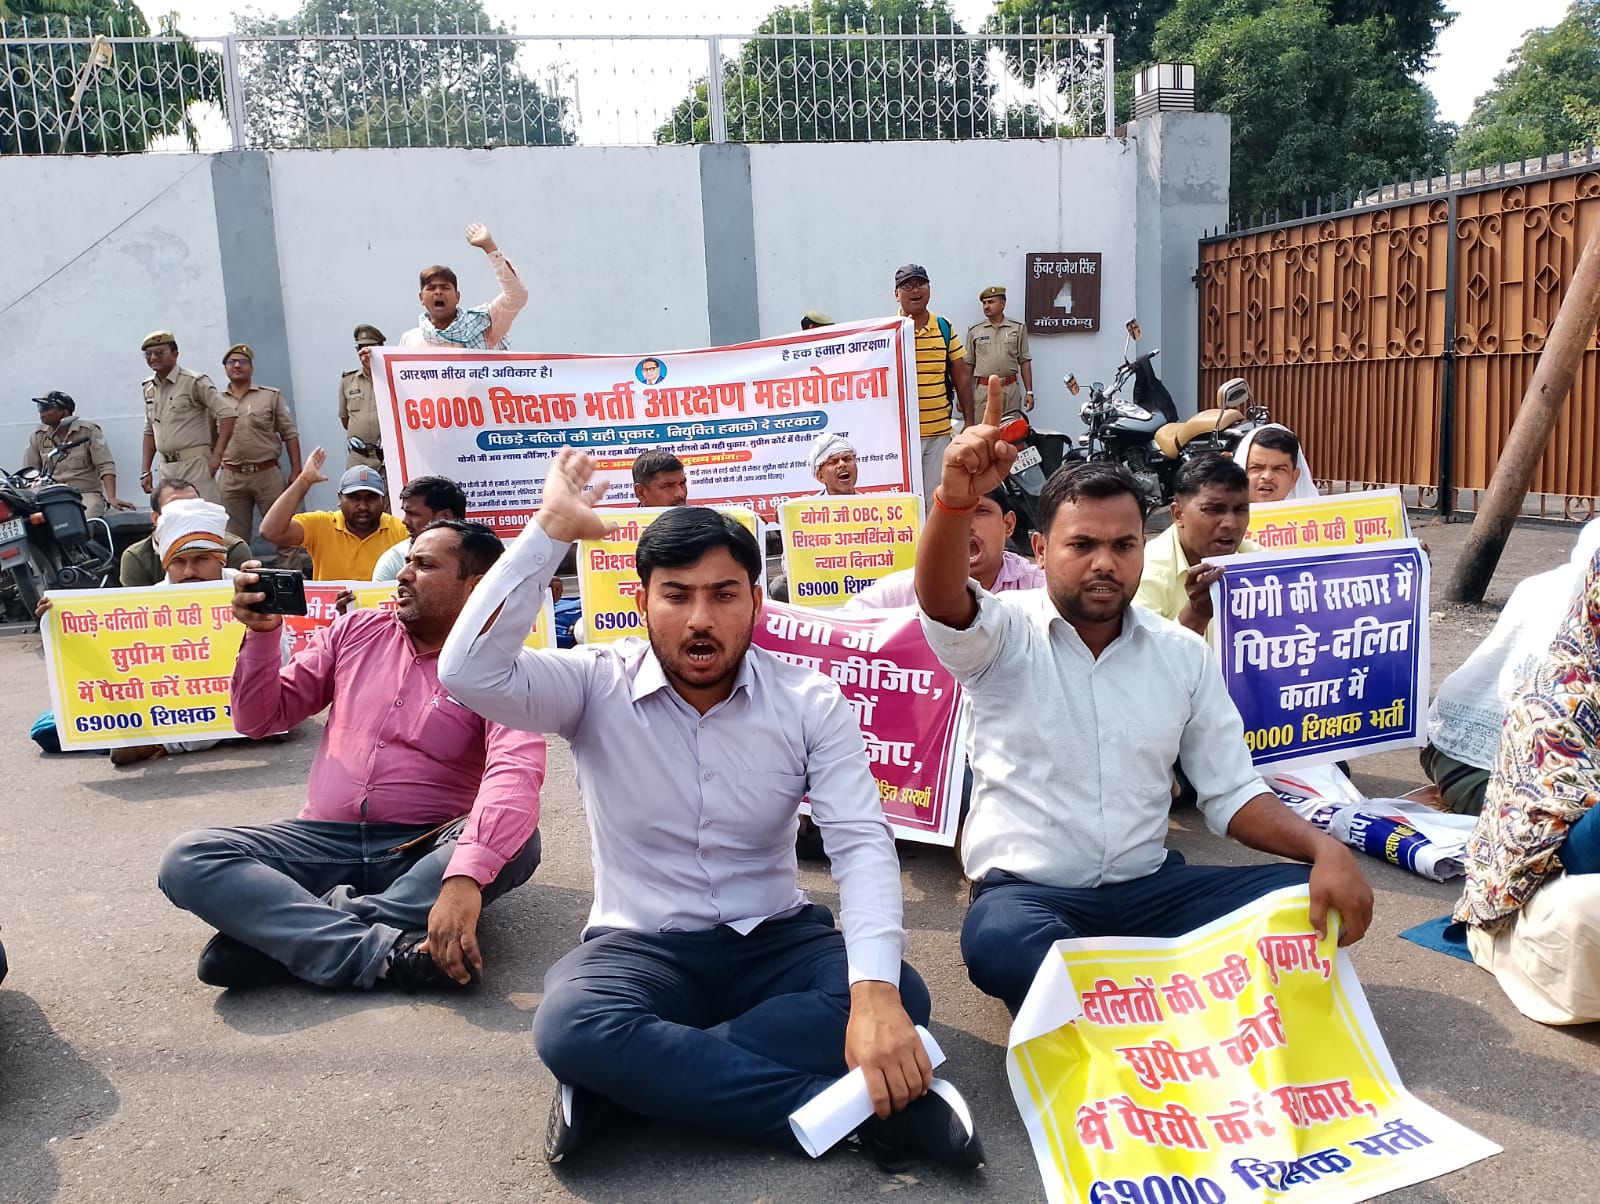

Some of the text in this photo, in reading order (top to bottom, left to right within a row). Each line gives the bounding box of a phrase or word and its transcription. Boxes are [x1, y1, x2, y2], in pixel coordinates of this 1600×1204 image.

[1079, 257, 1096, 275] सिंह
[1053, 281, 1072, 314] 4
[1034, 316, 1060, 327] मॉल
[782, 349, 791, 361] है
[793, 347, 812, 360] हक
[815, 343, 846, 359] हमारा
[400, 367, 438, 381] आरक्षण
[440, 366, 466, 380] भीख
[492, 365, 537, 379] अधिकार
[404, 366, 890, 430] 69000 शिक्षक भर्ती आरक्षण महाघोटाला
[488, 430, 566, 446] पिछड़े-दलितों
[570, 430, 590, 443] की
[591, 429, 616, 441] यही
[619, 428, 660, 445] पुकार,
[718, 418, 760, 434] हमको
[773, 414, 822, 429] सरकार
[458, 452, 476, 463] योगी
[700, 441, 710, 450] की
[801, 505, 903, 525] योगी जी OBC, SC
[792, 525, 914, 548] शिक्षक अभ्यर्थियों को
[1243, 515, 1392, 549] -दलितों की यही पुकार,
[815, 556, 847, 570] न्याय
[797, 580, 839, 597] 69000
[1230, 562, 1414, 620] योगी की सरकार में
[61, 602, 237, 638] पिछड़े-दलितों की यही पुक
[111, 637, 210, 673] सुप्रीम कोर्ट
[1233, 616, 1413, 677] पिछड़े-दलित
[78, 675, 231, 703] में पैरवी करें सरक
[829, 656, 944, 701] कीजिए,
[1279, 666, 1371, 712] कतार में
[75, 712, 143, 733] 69000
[149, 704, 217, 727] शिक्षक
[1244, 697, 1406, 751] 9000 शिक्षक भर्ती
[899, 784, 933, 809] अभ्यर्थी
[1080, 976, 1164, 1025] दलितों
[1160, 973, 1206, 1015] की
[1203, 953, 1253, 1000] यही
[1115, 1040, 1220, 1091] सुप्रीम
[1076, 1102, 1116, 1151] में
[1110, 1096, 1208, 1150] पैरवी
[1230, 1148, 1352, 1191] शिक्षक
[1348, 1118, 1434, 1157] भर्ती
